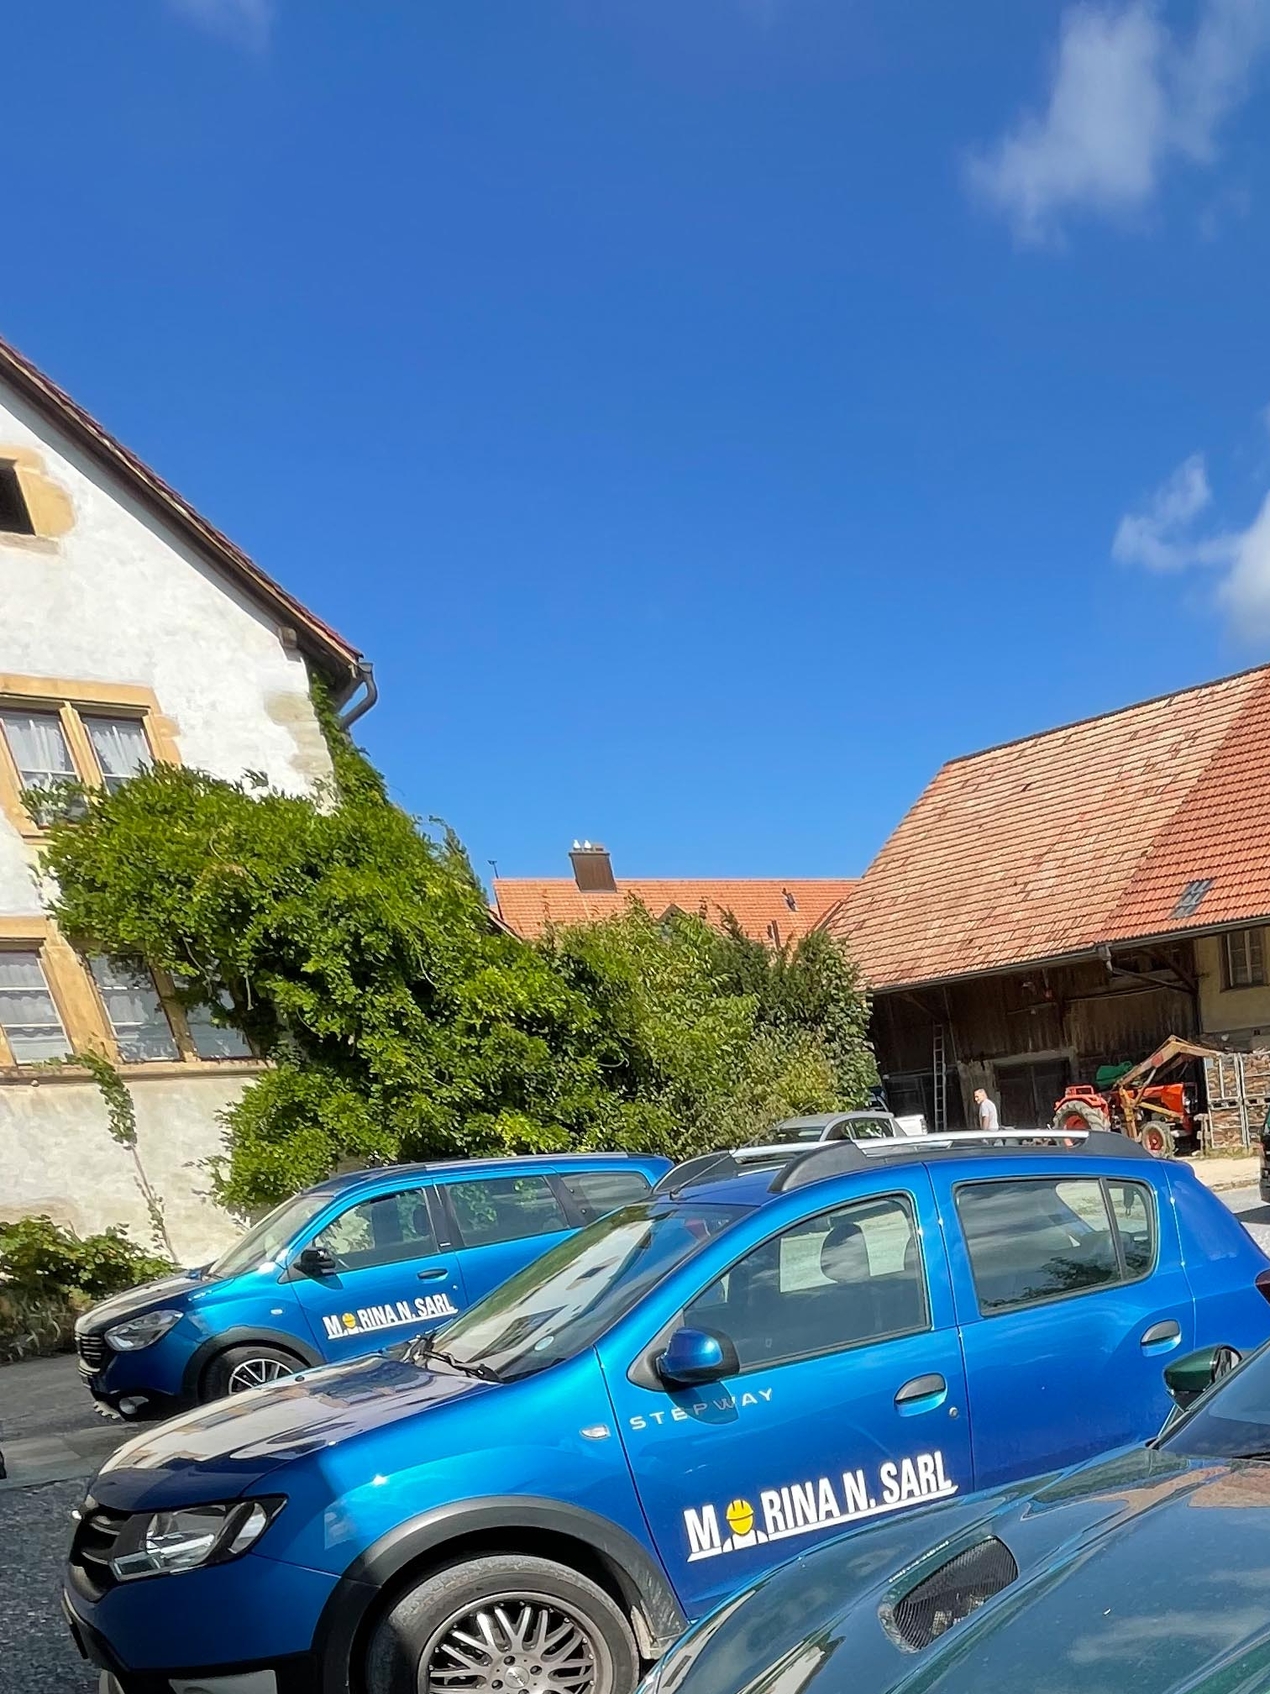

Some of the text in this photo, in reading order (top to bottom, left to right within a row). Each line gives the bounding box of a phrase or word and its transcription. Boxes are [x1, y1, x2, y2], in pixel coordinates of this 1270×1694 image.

[396, 1301, 416, 1320] N.
[415, 1293, 454, 1317] SARL
[629, 1388, 773, 1430] STEPWAY
[842, 1469, 876, 1513] N.
[880, 1450, 952, 1505] SARL
